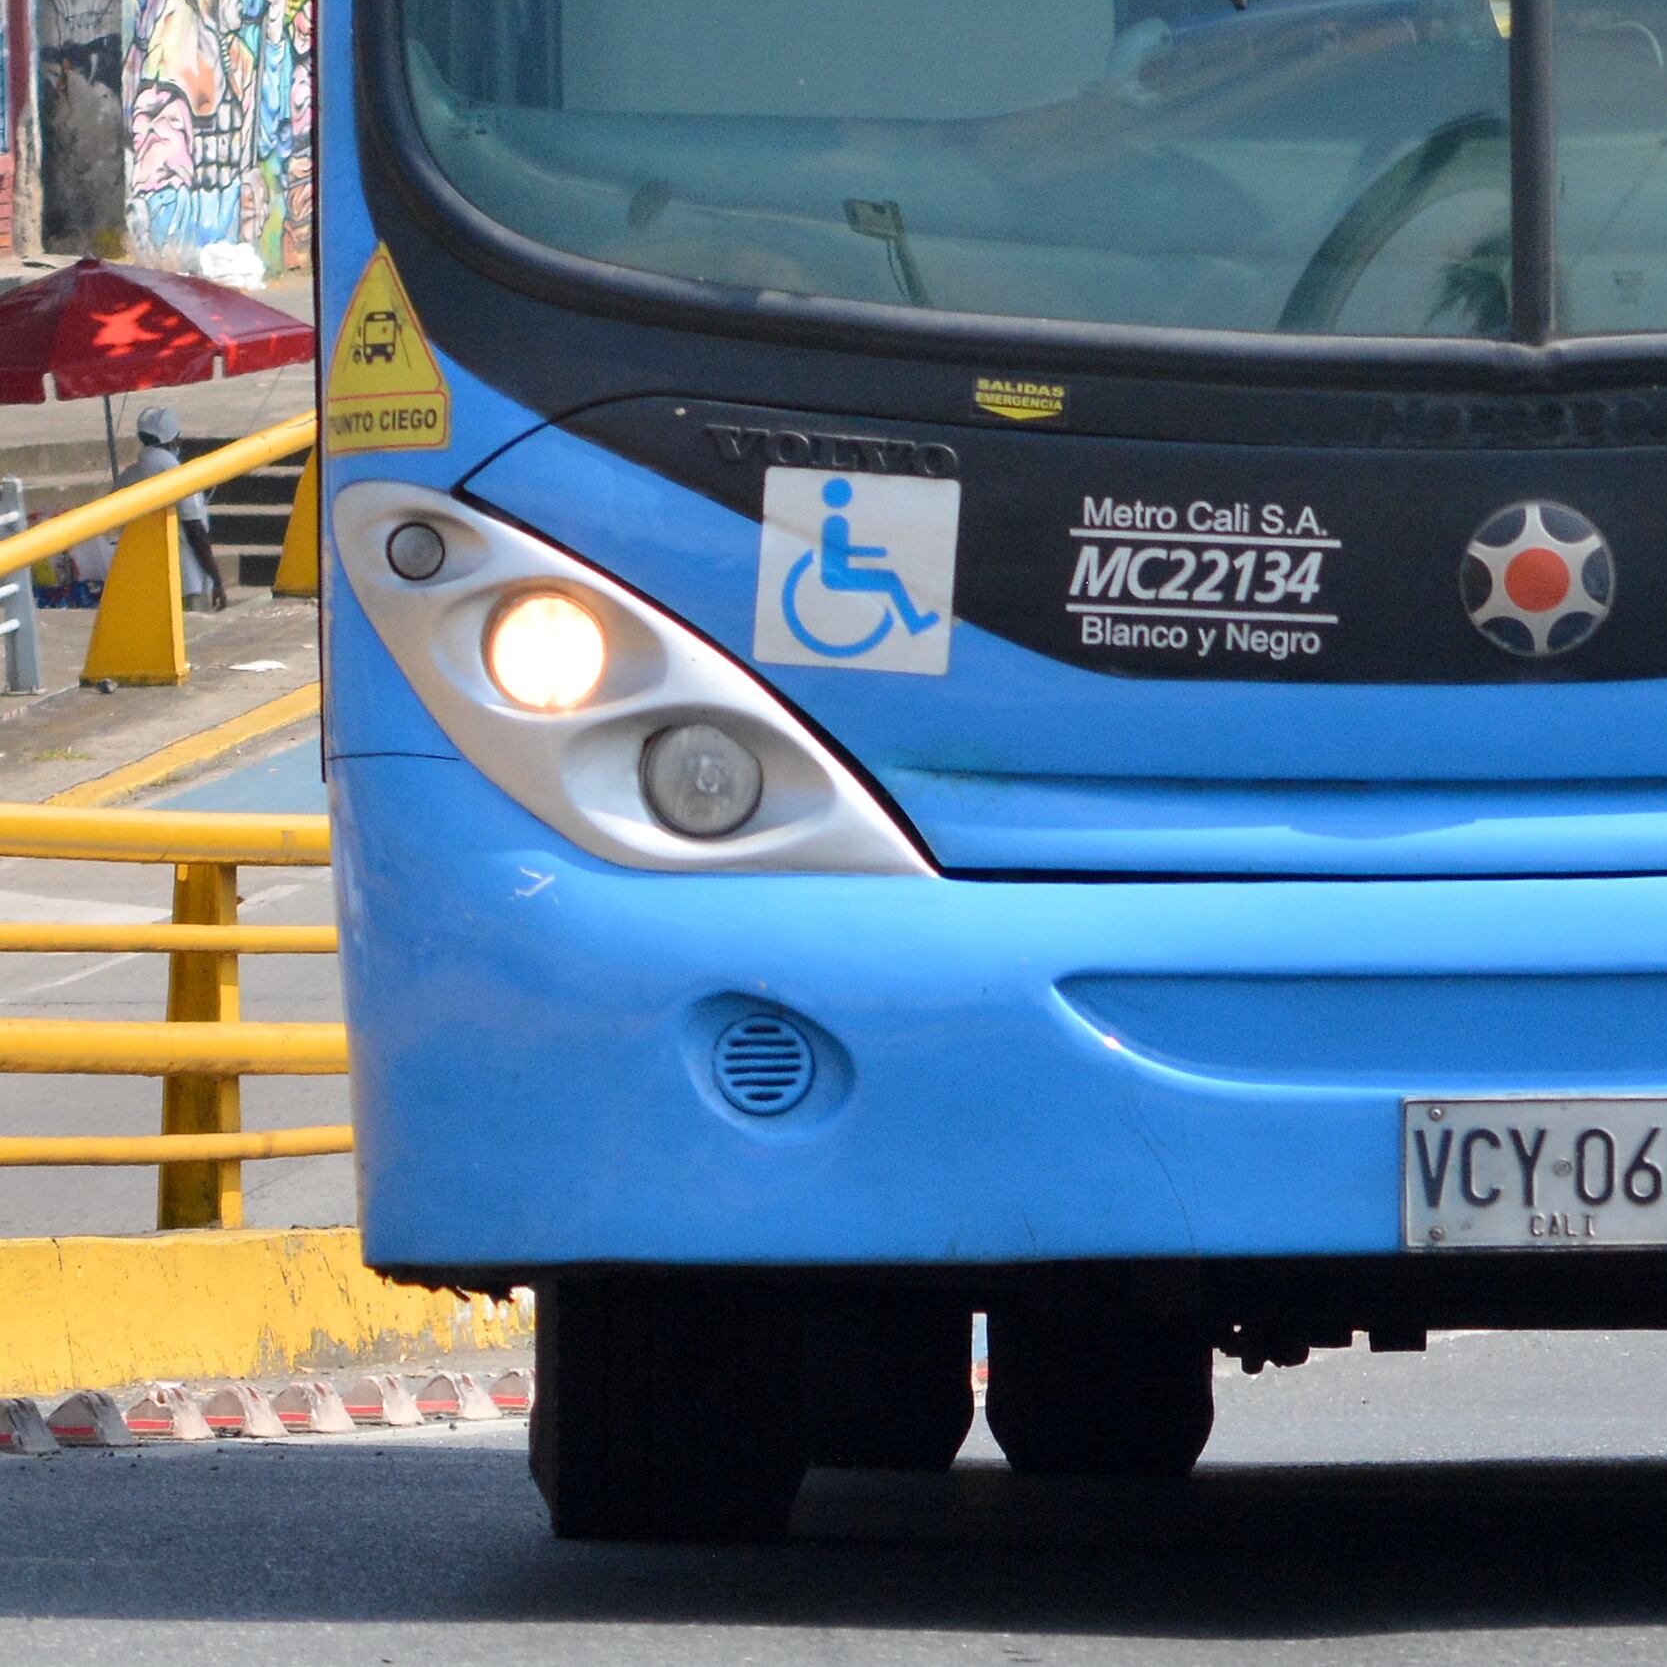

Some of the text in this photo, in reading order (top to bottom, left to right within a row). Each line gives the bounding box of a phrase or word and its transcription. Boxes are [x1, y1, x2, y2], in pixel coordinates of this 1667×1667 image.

[975, 391, 1063, 411] EMERGENCIA
[977, 378, 1066, 398] SALIDAS
[379, 407, 438, 431] CIEGO
[703, 422, 960, 476] VOLVO
[1082, 495, 1329, 537] Metro Cali S.A.
[1067, 545, 1324, 604] MC22134
[1081, 615, 1322, 661] Blanco y Negro
[1413, 1126, 1547, 1209] VCY
[1529, 1212, 1598, 1239] CALI
